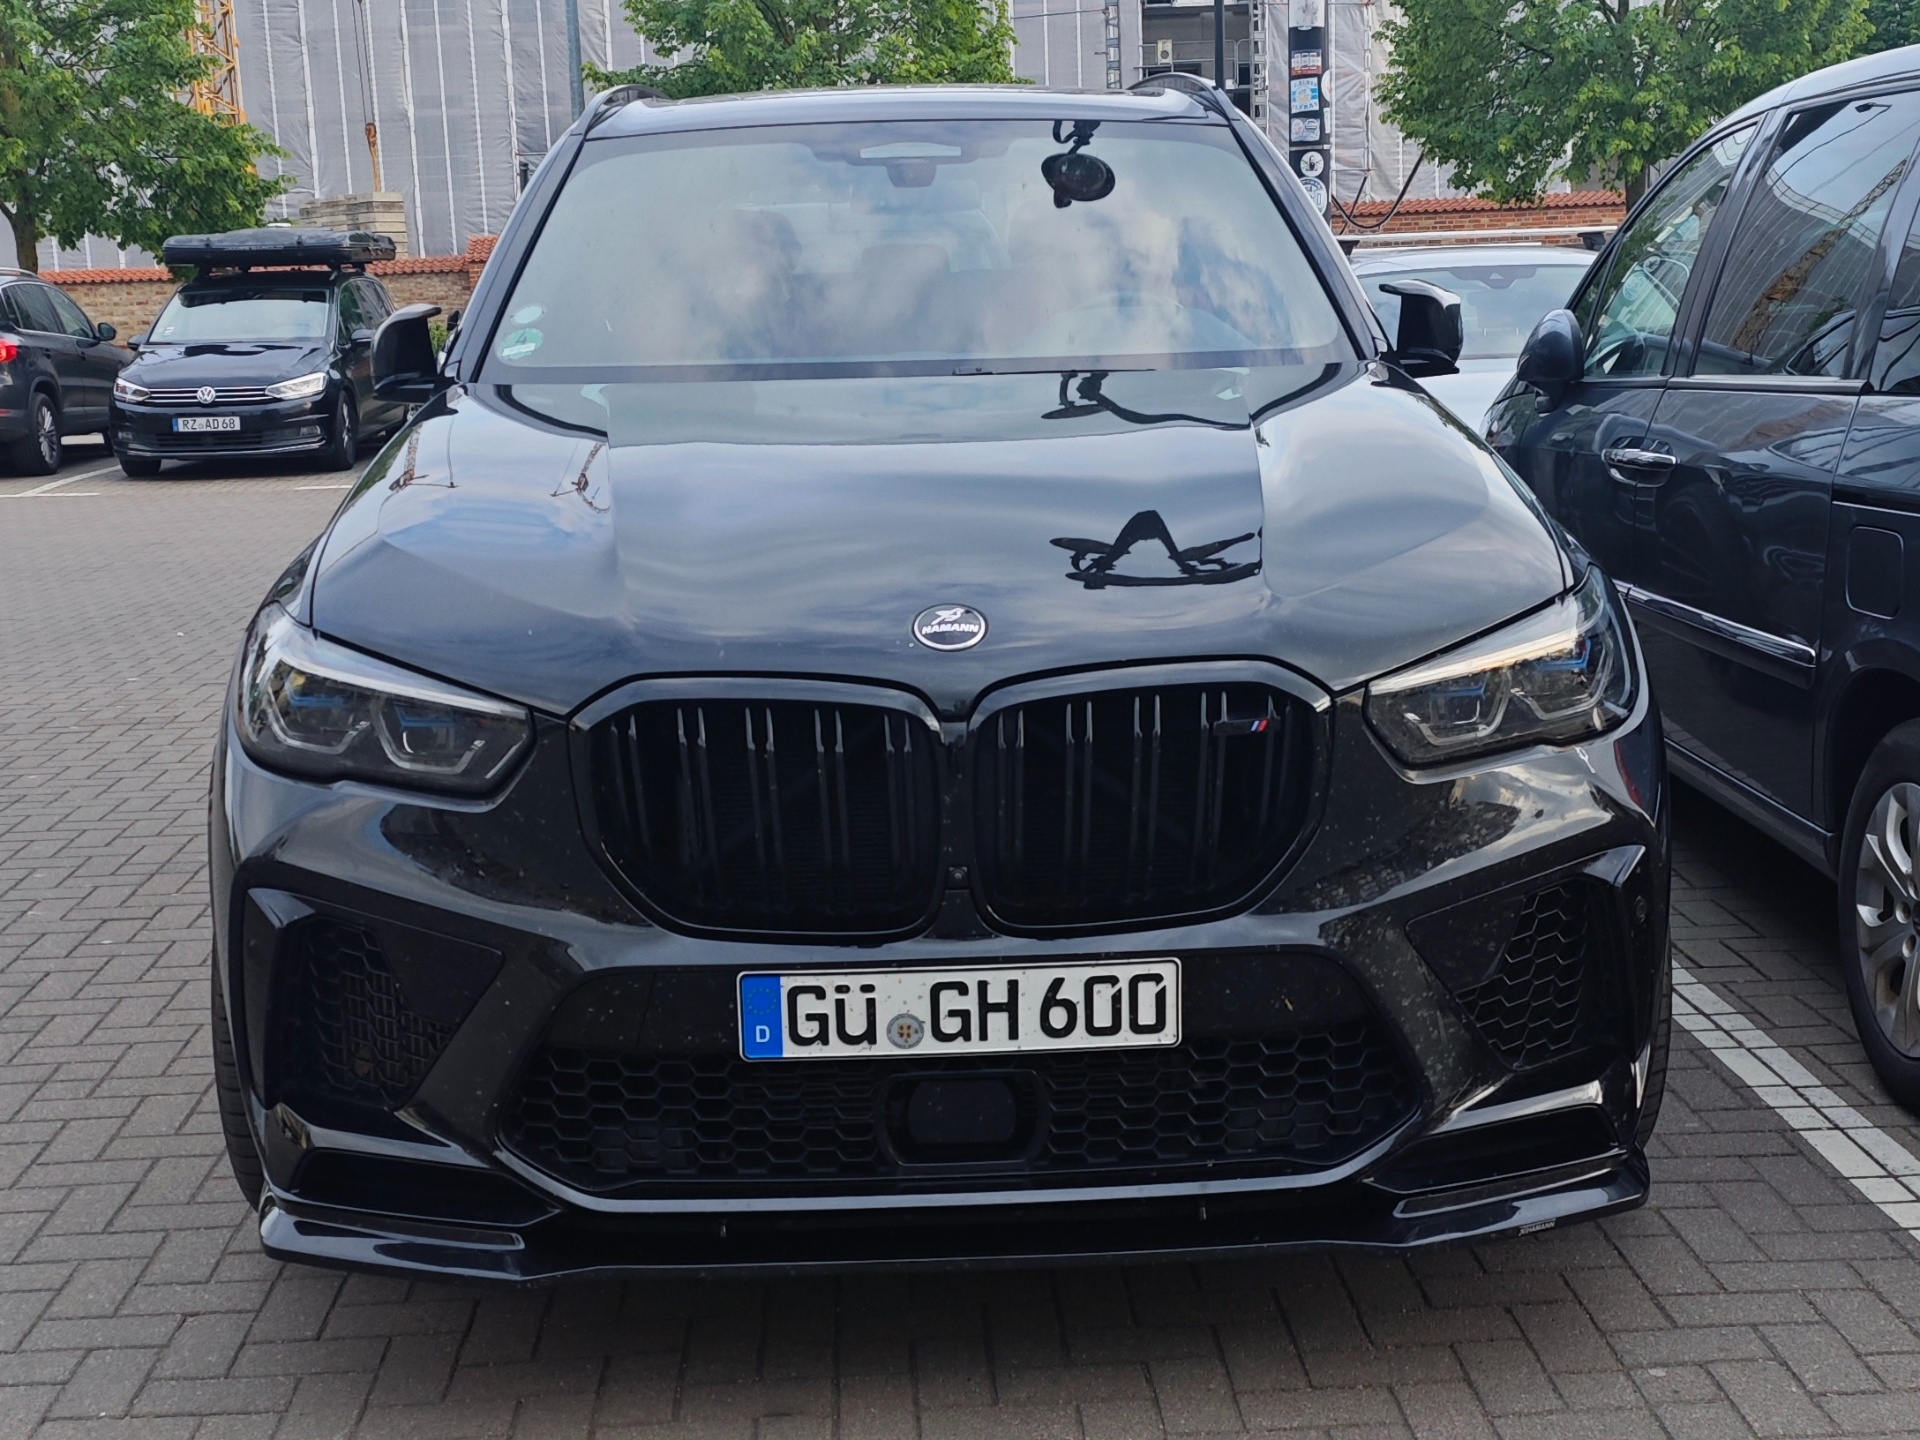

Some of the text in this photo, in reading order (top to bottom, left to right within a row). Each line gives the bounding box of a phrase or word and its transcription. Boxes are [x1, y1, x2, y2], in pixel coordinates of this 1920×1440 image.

[182, 418, 236, 430] RZ AD 68
[921, 623, 979, 635] HAMANN
[786, 983, 878, 1047] GÜ
[929, 978, 1020, 1043] GH
[1039, 972, 1168, 1039] 600
[754, 1025, 770, 1043] D
